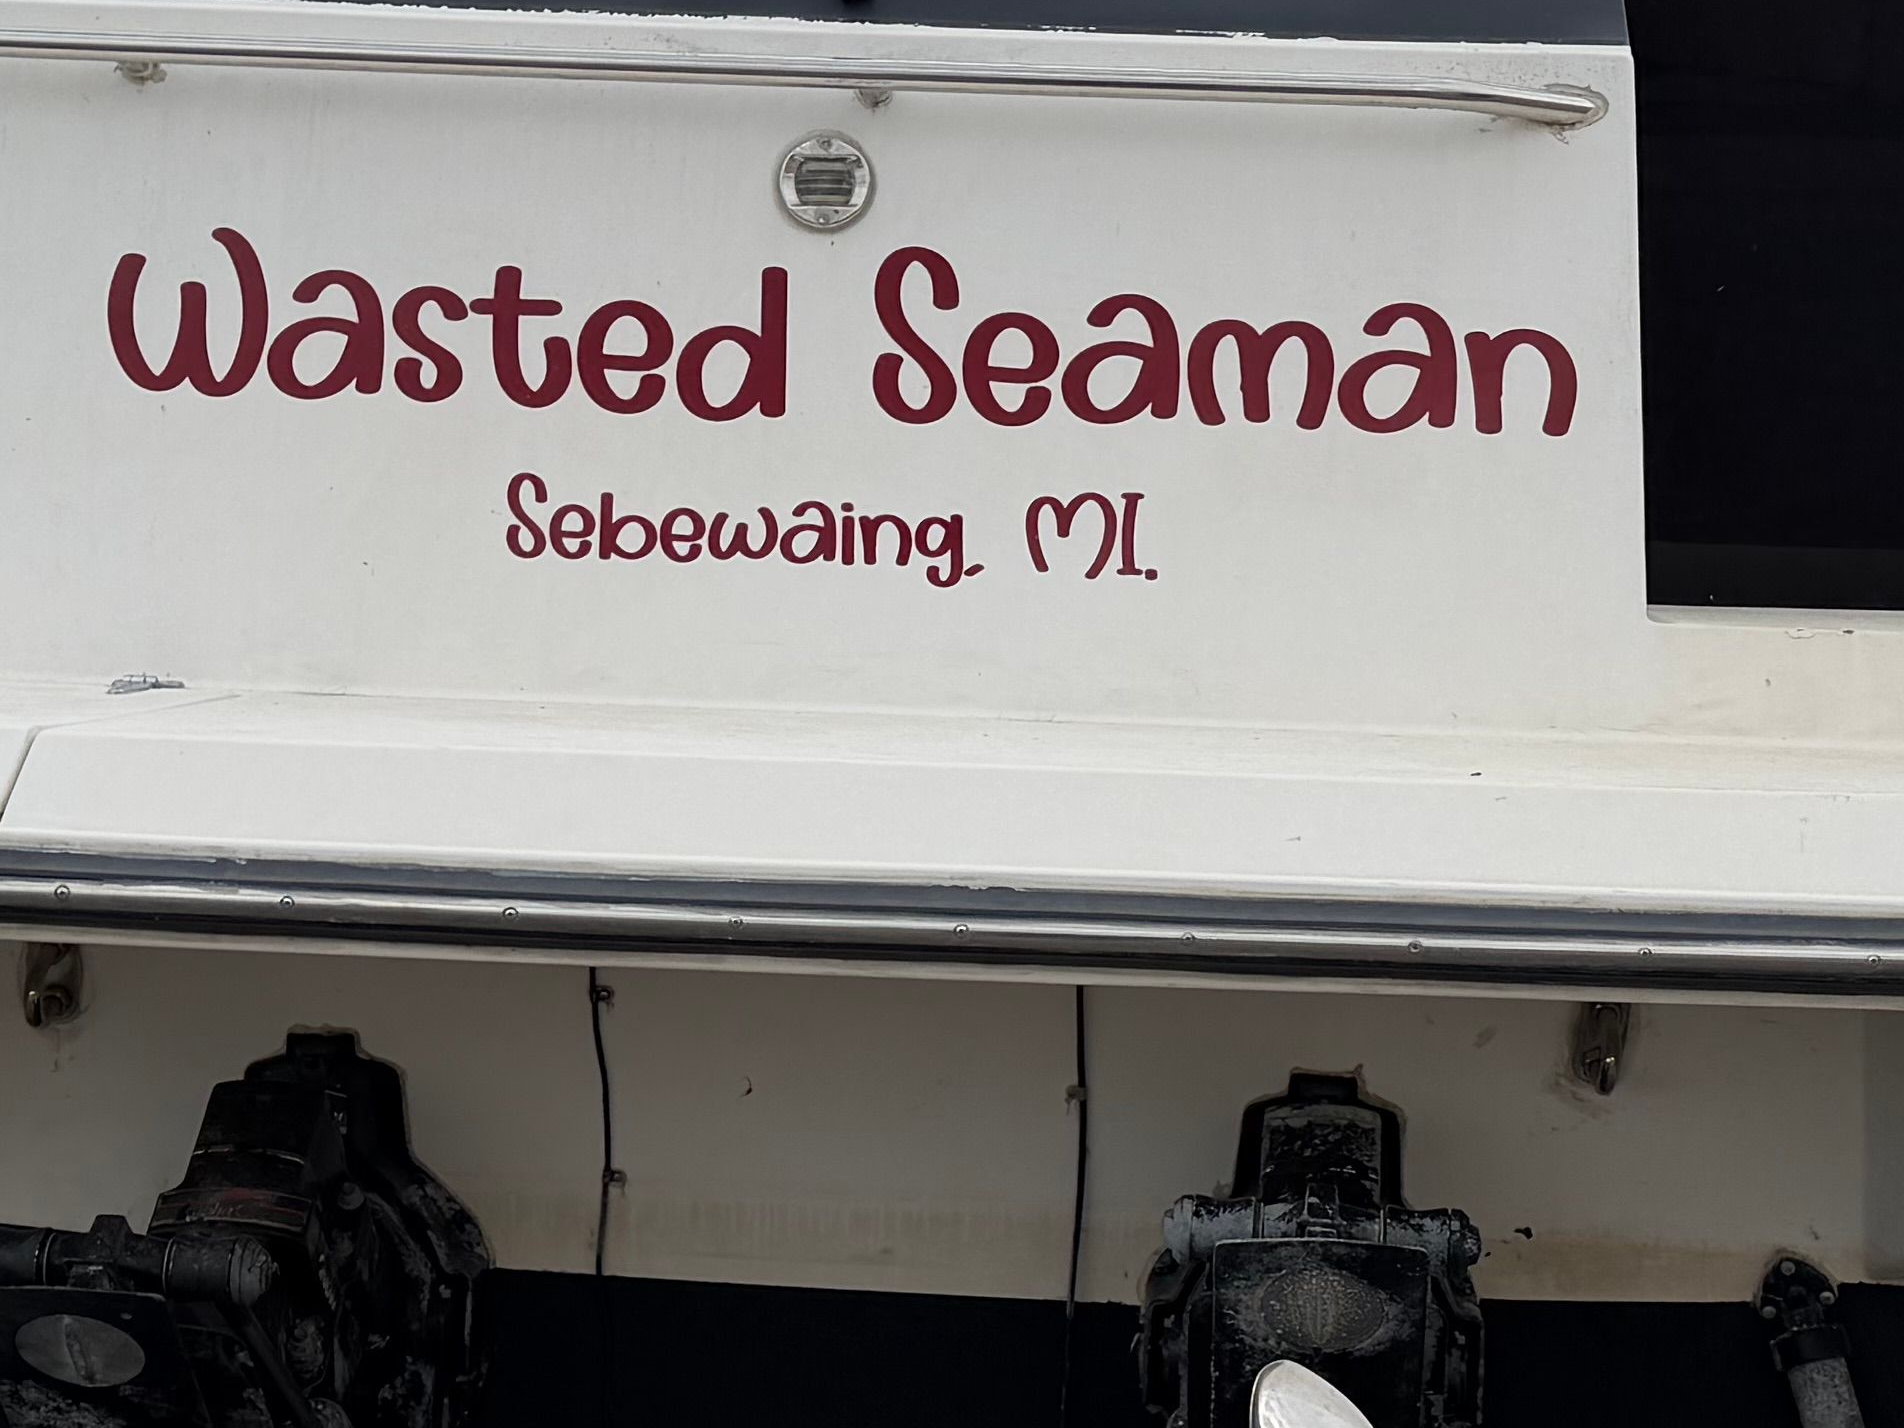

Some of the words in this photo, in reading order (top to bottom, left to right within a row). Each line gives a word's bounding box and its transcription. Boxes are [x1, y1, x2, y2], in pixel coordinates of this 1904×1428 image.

[107, 229, 790, 423] Wasted
[871, 246, 1578, 438] Seaman
[507, 472, 985, 589] Sebewaing,
[1025, 491, 1158, 581] MI.
